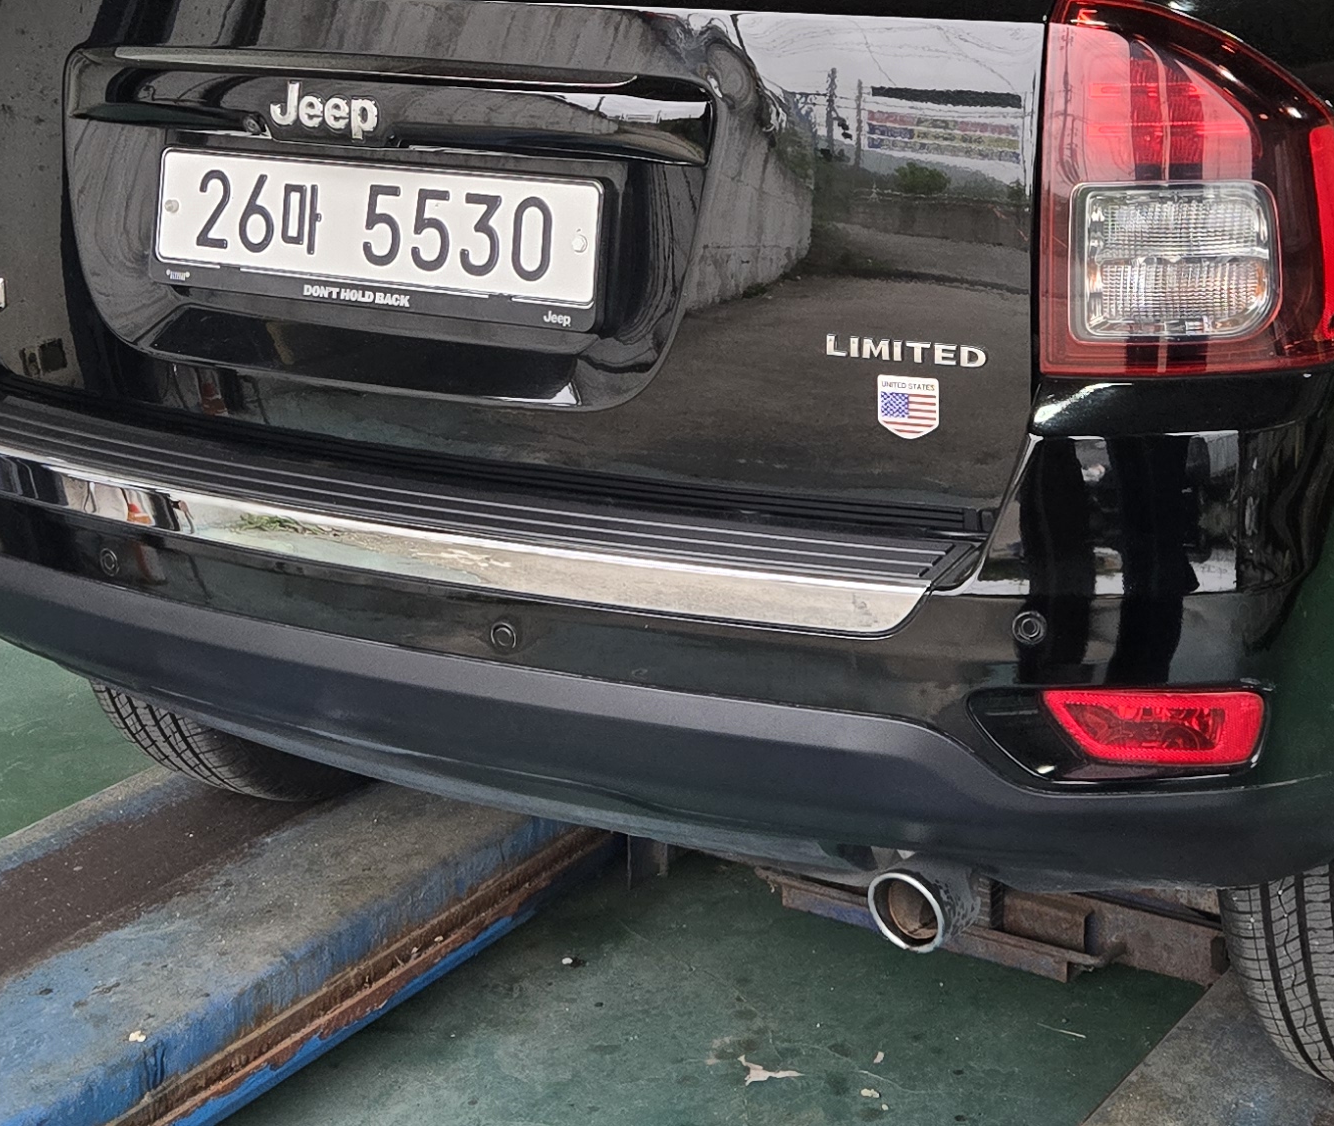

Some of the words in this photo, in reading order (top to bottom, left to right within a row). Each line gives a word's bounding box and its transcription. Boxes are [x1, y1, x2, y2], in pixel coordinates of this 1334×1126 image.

[269, 80, 379, 140] Jeep
[195, 168, 322, 256] 26마
[362, 184, 553, 282] 5530
[302, 284, 340, 299] DON'T
[340, 288, 375, 303] HOLD
[374, 292, 410, 308] BACK
[543, 310, 571, 327] Jeep
[825, 333, 988, 368] LIMITED
[881, 380, 907, 390] UNITED
[907, 382, 936, 392] STATES
